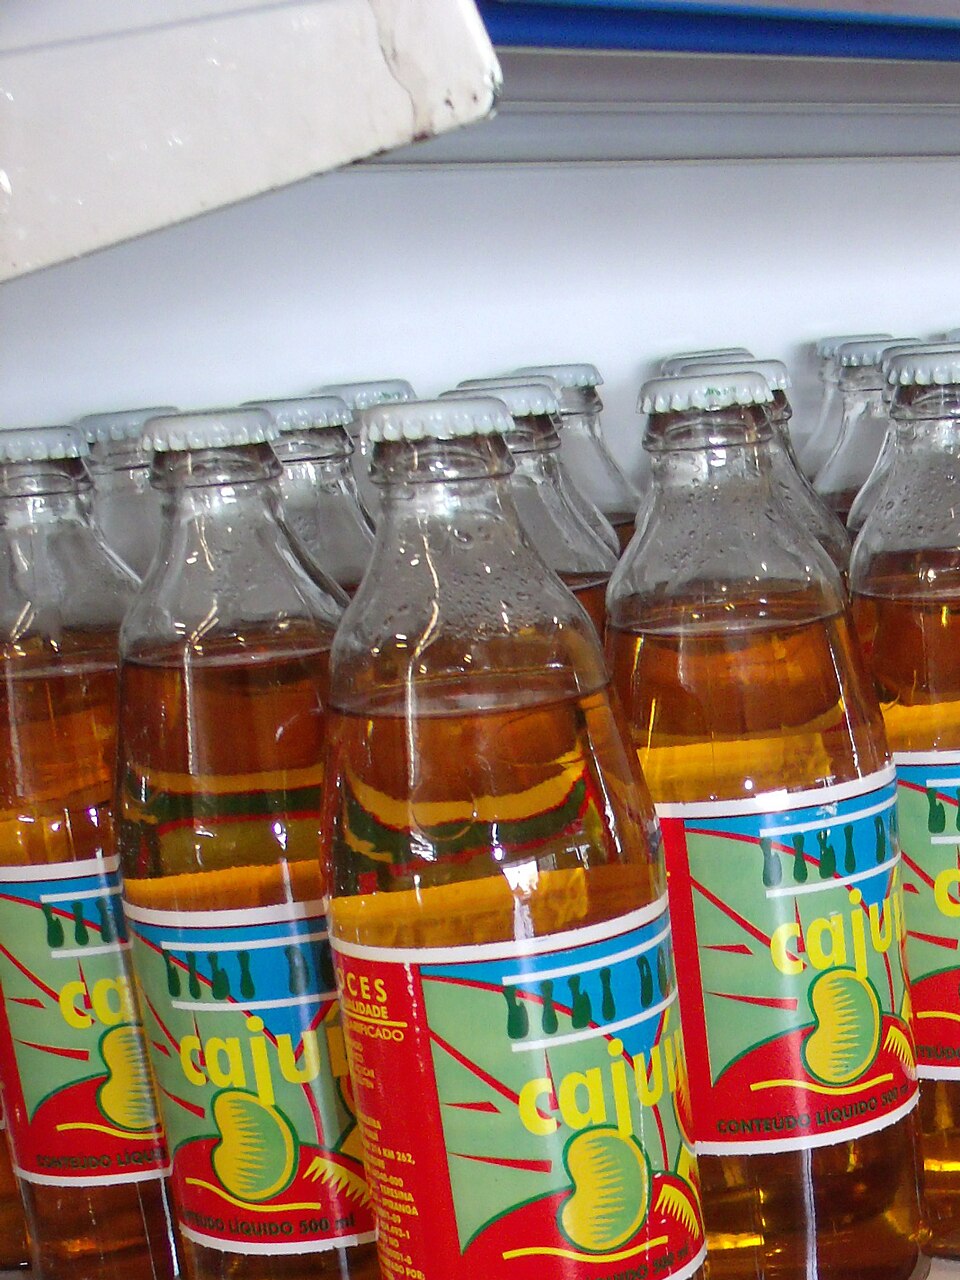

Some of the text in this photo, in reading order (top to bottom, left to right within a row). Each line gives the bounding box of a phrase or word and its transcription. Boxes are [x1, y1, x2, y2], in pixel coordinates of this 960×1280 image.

[717, 1111, 811, 1135] CONTEÚDO
[816, 1092, 878, 1125] LÍQUIDO
[228, 1218, 294, 1236] LÍQUIDO
[298, 1217, 330, 1235] 500
